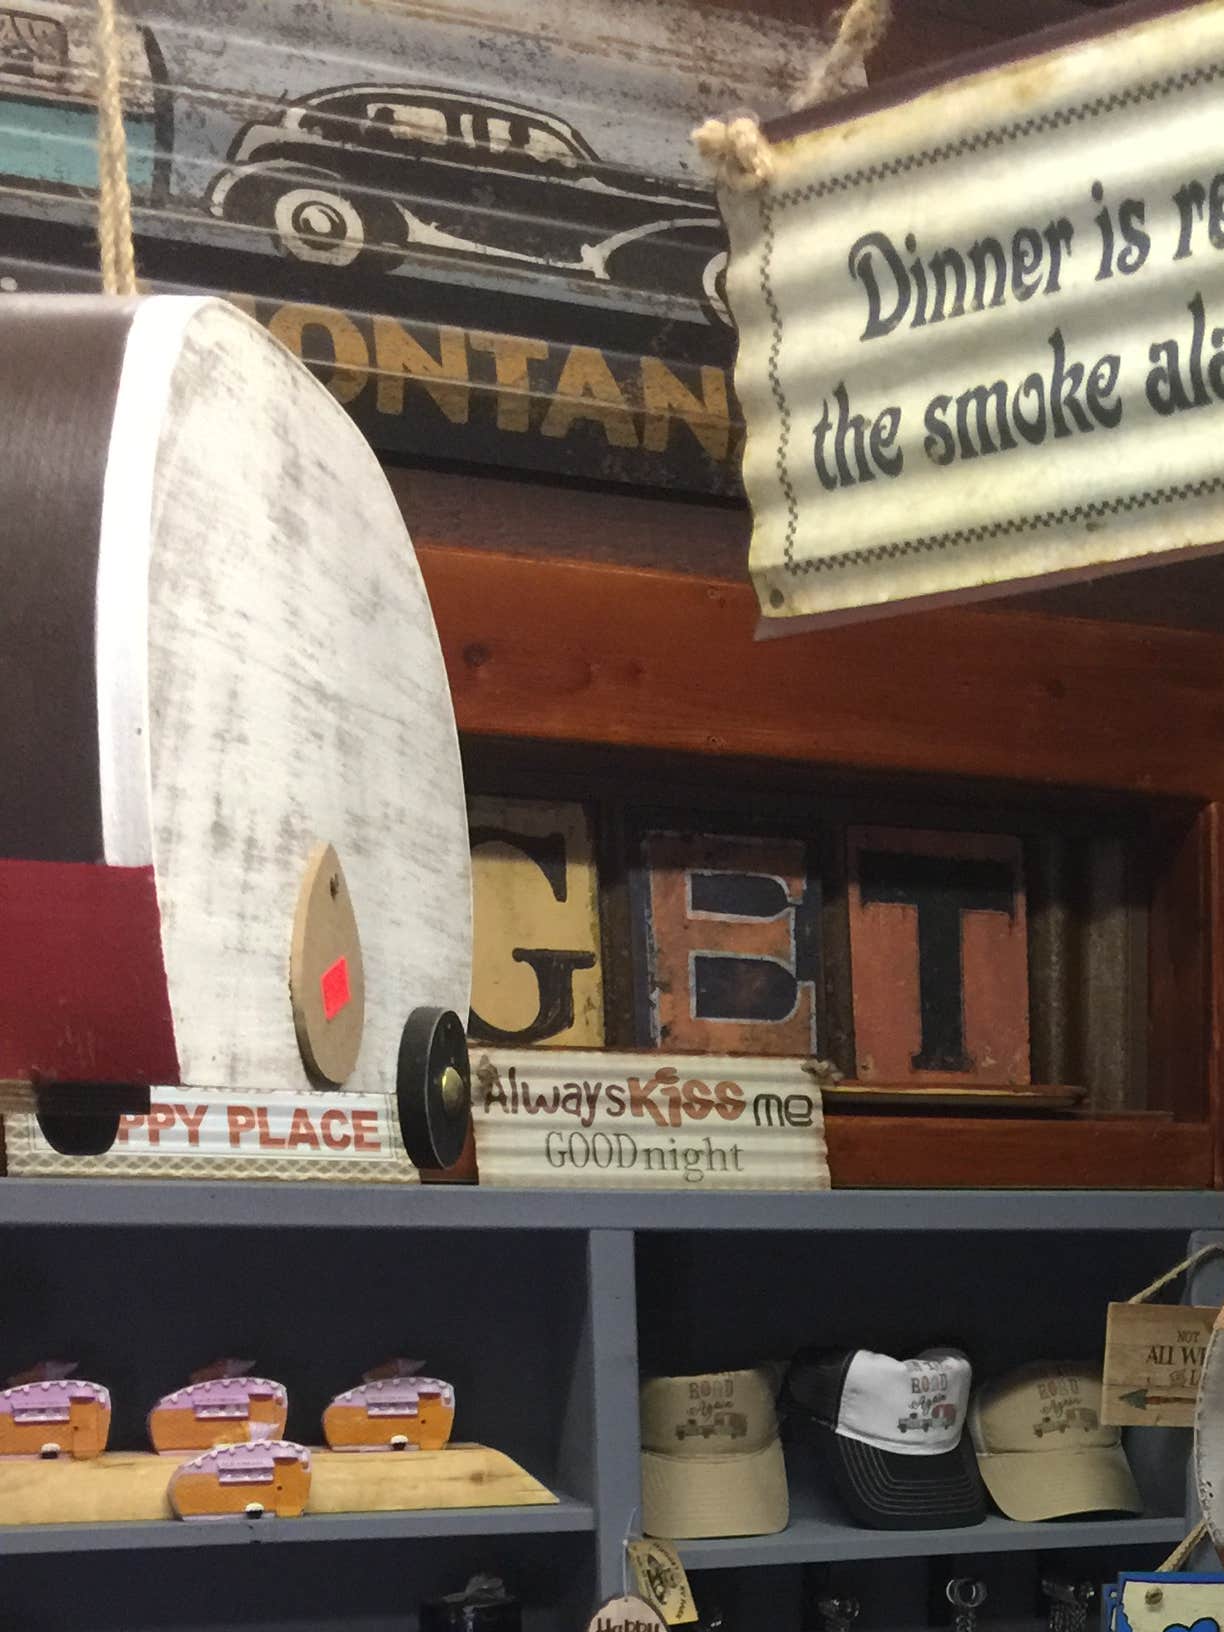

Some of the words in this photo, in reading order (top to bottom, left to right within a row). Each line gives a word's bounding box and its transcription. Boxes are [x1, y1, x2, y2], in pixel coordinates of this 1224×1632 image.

[848, 217, 1075, 342] Dinner
[1090, 182, 1152, 284] is
[238, 298, 731, 462] ONTAN
[813, 384, 905, 491] the
[923, 330, 1123, 467] smoke
[117, 1102, 209, 1148] PPY
[227, 1104, 383, 1153] PLACE
[483, 1066, 626, 1128] Always
[753, 1092, 815, 1128] me
